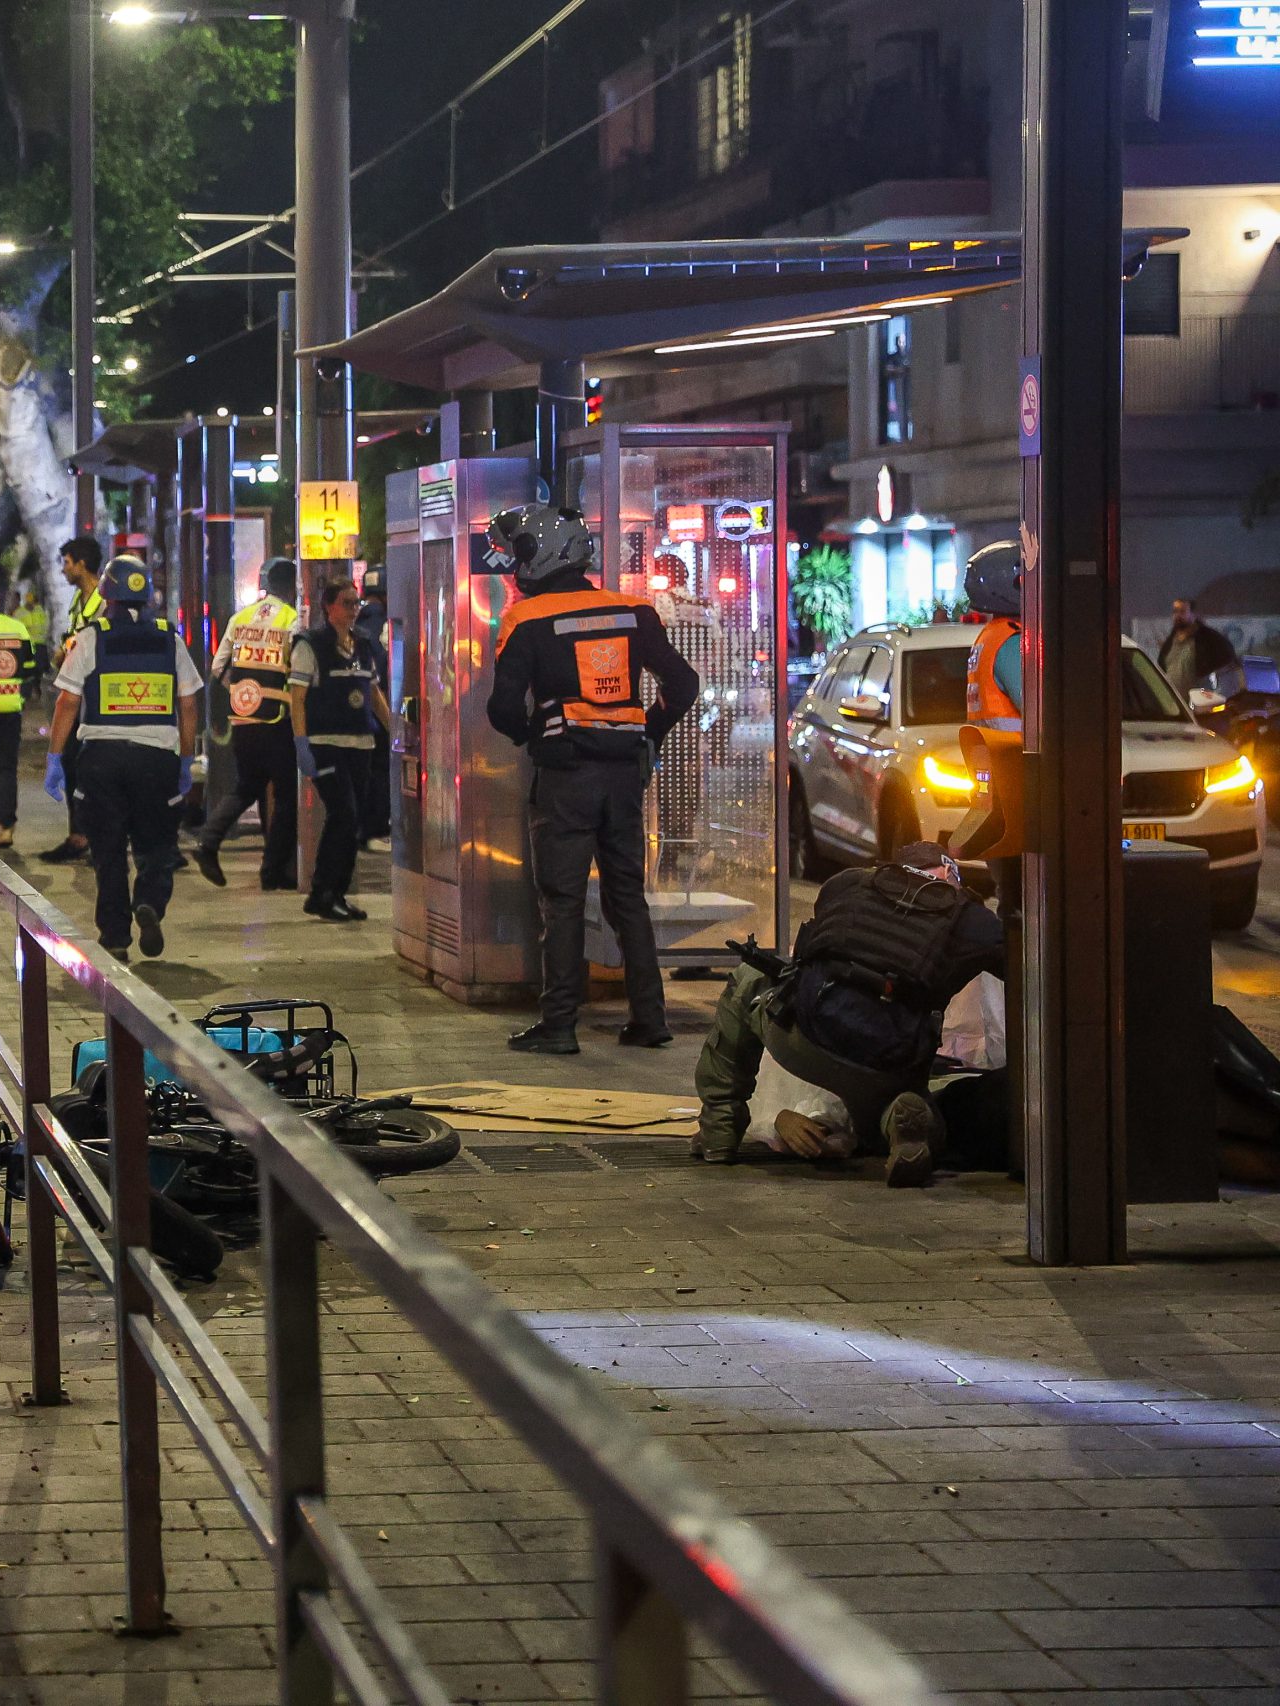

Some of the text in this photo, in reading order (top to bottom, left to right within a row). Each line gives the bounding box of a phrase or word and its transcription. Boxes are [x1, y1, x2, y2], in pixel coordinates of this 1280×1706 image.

[320, 488, 338, 511] 11
[323, 519, 335, 542] 5
[594, 676, 620, 686] איחוד
[594, 685, 621, 695] הצלה
